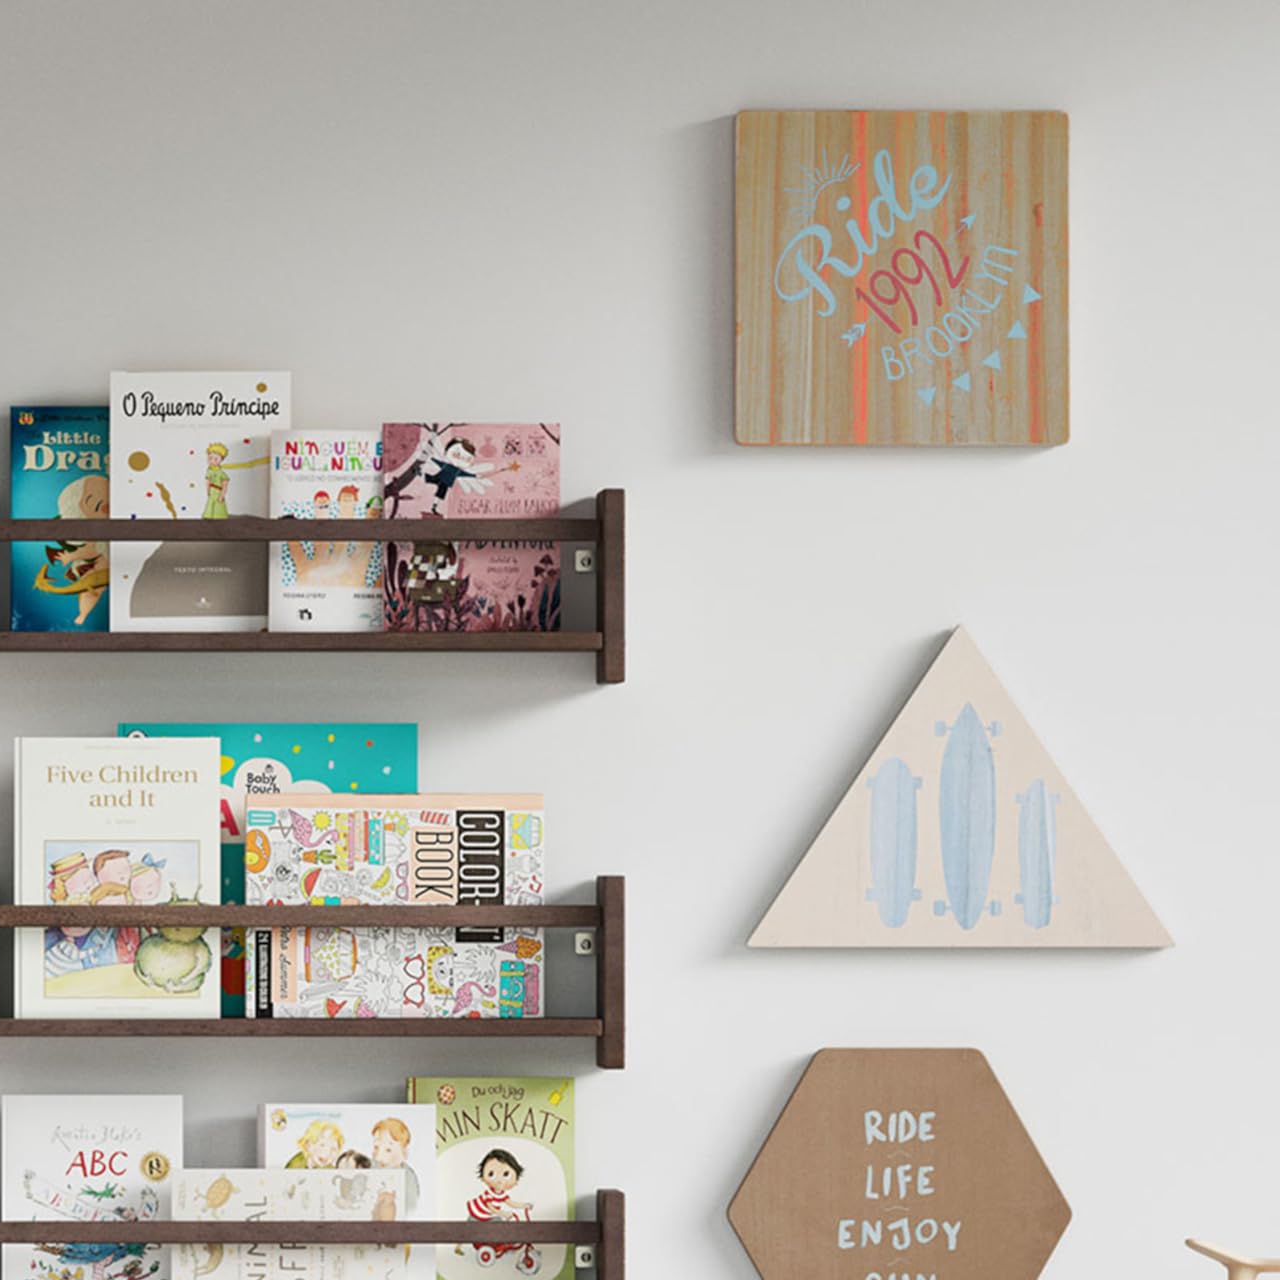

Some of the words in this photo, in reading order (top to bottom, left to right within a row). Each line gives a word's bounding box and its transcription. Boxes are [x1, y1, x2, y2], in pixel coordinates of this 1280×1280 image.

[775, 149, 952, 317] Ride
[856, 230, 970, 334] 1992
[122, 391, 138, 418] O
[141, 391, 206, 423] Pequeno
[42, 431, 101, 446] Little
[22, 444, 110, 472] Dra
[331, 456, 383, 472] NINGU
[47, 765, 94, 784] Five
[99, 764, 198, 784] Children
[246, 772, 277, 786] Baby
[89, 789, 133, 807] and
[140, 789, 154, 807] It
[415, 830, 454, 899] BOOK
[471, 1086, 486, 1098] Du
[488, 1101, 569, 1144] SKATT
[864, 1110, 937, 1144] RIDE
[65, 1149, 129, 1178] ABC
[864, 1164, 936, 1199] LIFE
[837, 1218, 962, 1251] ENJOY
